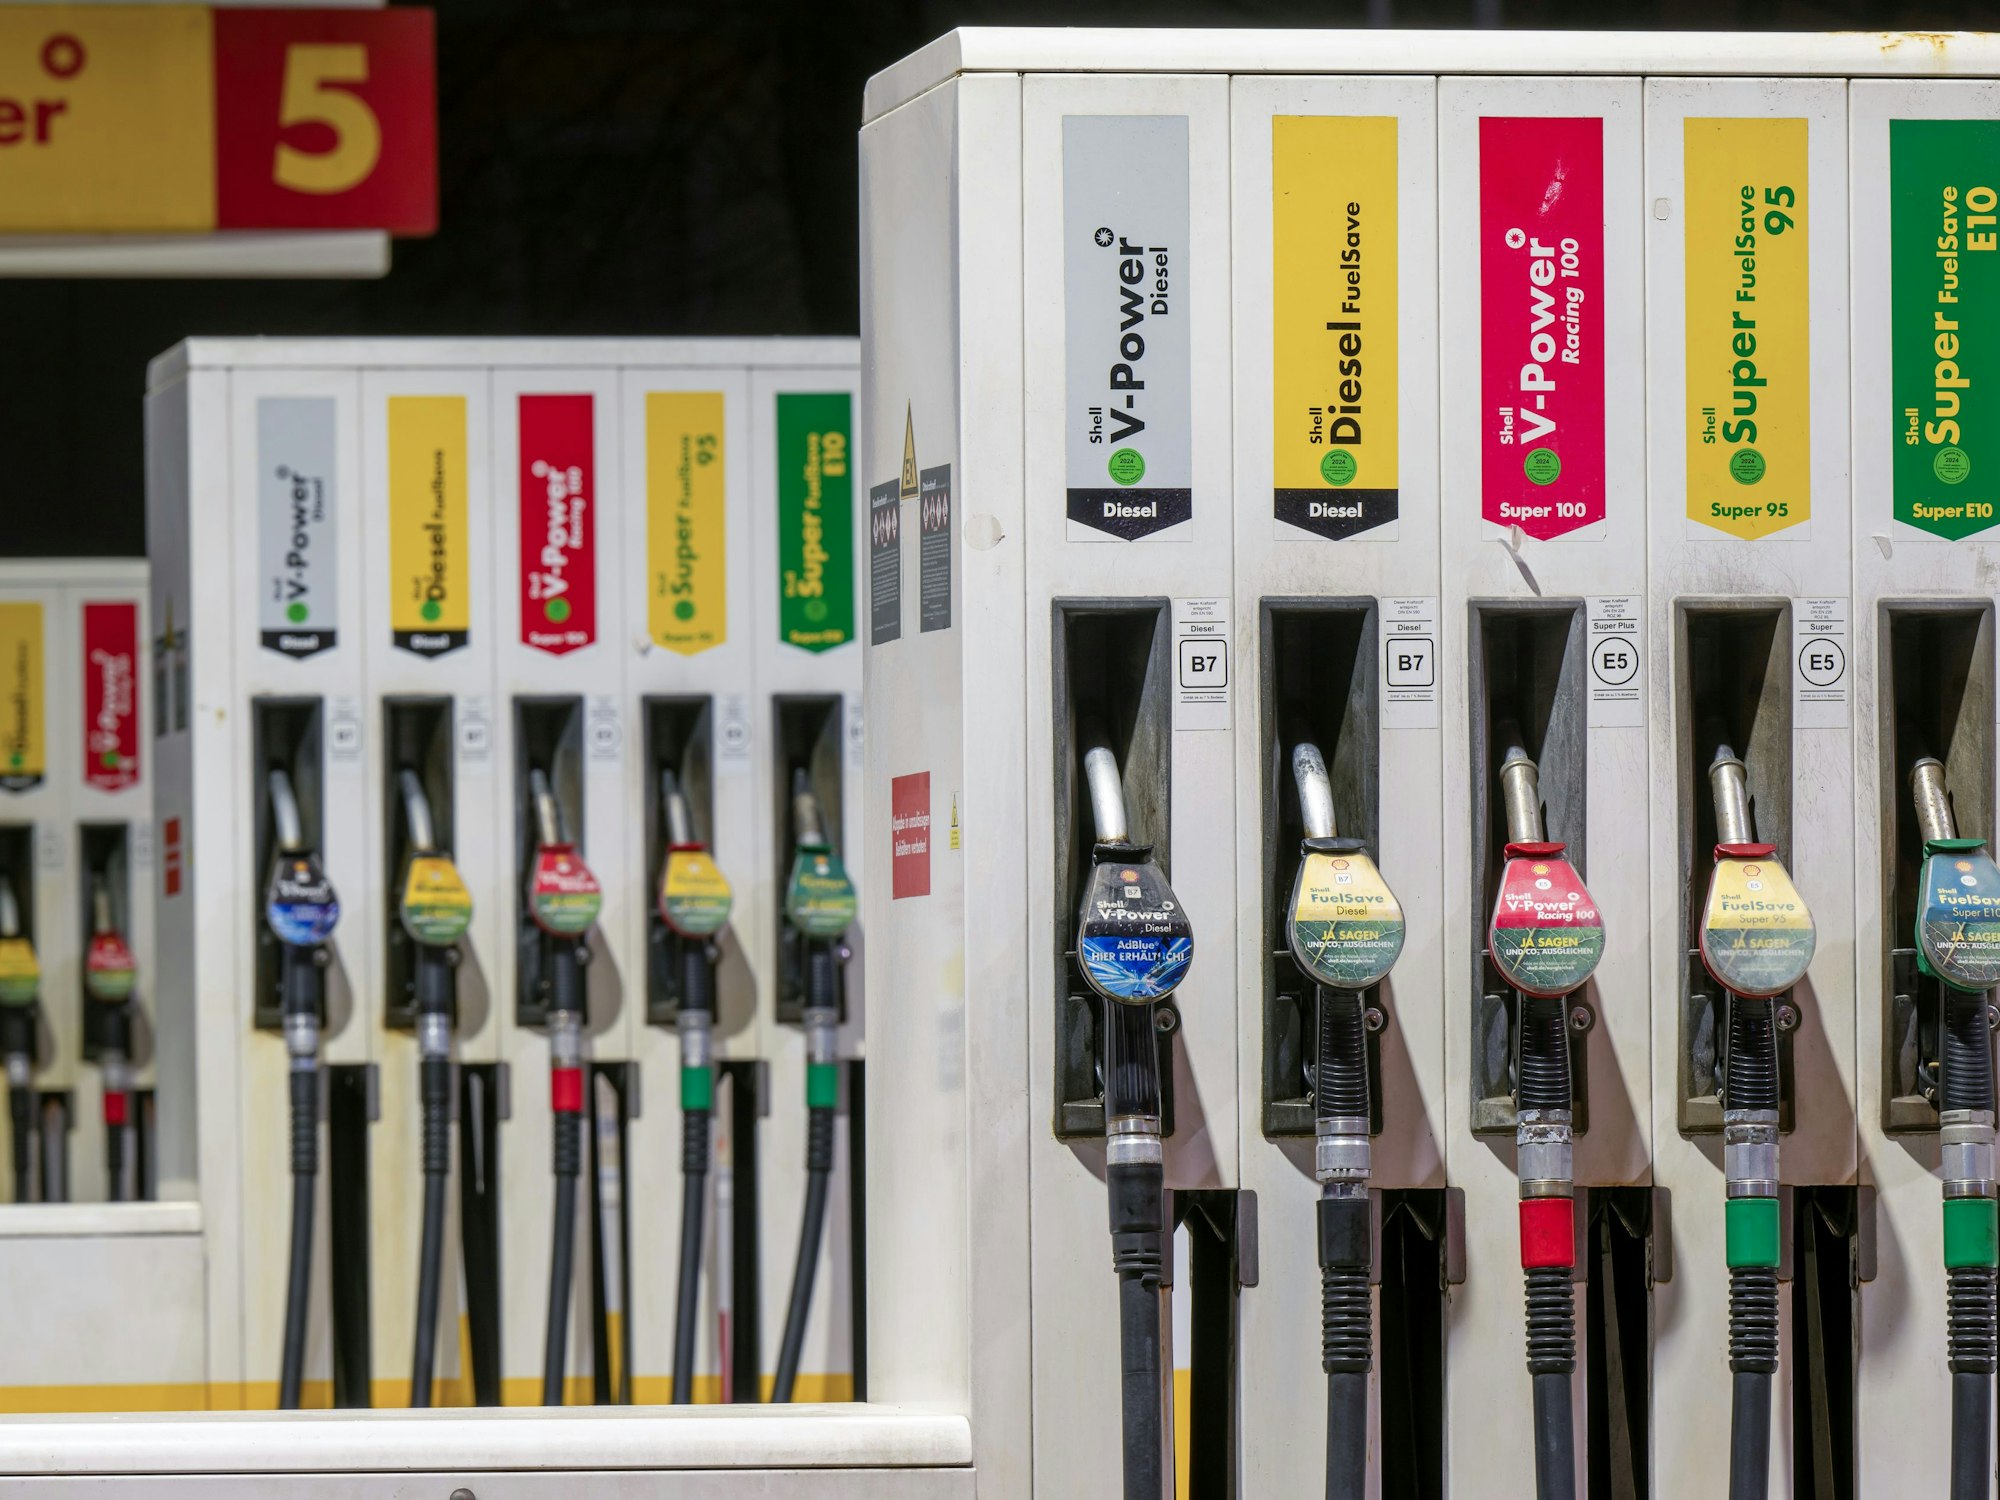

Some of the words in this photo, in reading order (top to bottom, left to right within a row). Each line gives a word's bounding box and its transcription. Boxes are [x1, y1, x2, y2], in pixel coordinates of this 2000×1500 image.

[272, 44, 382, 194] 5
[1764, 185, 1795, 236] 95
[1966, 186, 1998, 251] E10
[1340, 202, 1360, 314] FuelSave
[1562, 238, 1580, 278] 100
[1734, 185, 1756, 302] FuelSave
[1936, 186, 1958, 304] FuelSave
[1149, 247, 1168, 315] Diesel
[1110, 236, 1145, 444] V-Power
[1520, 237, 1556, 444] V-Power
[1560, 286, 1584, 364] Racing
[1326, 322, 1362, 445] Diesel
[1722, 311, 1767, 444] Super
[1924, 312, 1970, 445] Super
[1089, 407, 1102, 444] Shell
[1309, 407, 1322, 444] Shell
[1500, 406, 1514, 444] Shell
[1702, 407, 1716, 444] Shell
[1906, 408, 1919, 445] Shell
[696, 434, 716, 466] 95
[822, 432, 846, 476] E10
[1104, 502, 1157, 518] Diesel
[1310, 502, 1362, 518] Diesel
[1500, 502, 1552, 521] Super
[1556, 502, 1586, 518] 100
[1711, 502, 1762, 521] Super
[1766, 502, 1788, 517] 95
[1913, 502, 1964, 521] Super
[1966, 502, 1993, 518] E10
[286, 470, 309, 600] V-Power
[542, 466, 568, 599] V-Power
[424, 524, 446, 601] Diesel
[672, 515, 698, 596] Super
[798, 511, 828, 598] Super
[1594, 622, 1616, 630] Super
[1192, 656, 1217, 672] B7
[1398, 654, 1424, 671] B7
[1604, 654, 1628, 669] E5
[1810, 654, 1834, 670] E5
[1098, 909, 1170, 920] V-Power
[1311, 893, 1384, 903] FuelSave
[1337, 906, 1367, 915] Diesel
[1506, 901, 1575, 911] V-Power
[1722, 901, 1794, 911] FuelSave
[1953, 907, 1980, 919] Super
[1145, 924, 1171, 932] Diesel
[1537, 912, 1573, 921] Racing
[1740, 914, 1768, 926] Super
[1774, 914, 1786, 923] 95
[1322, 931, 1335, 940] JA
[1339, 931, 1379, 940] SAGEN
[1520, 938, 1534, 947] JA
[1538, 938, 1578, 947] SAGEN
[1732, 939, 1745, 948] JA
[1750, 939, 1789, 948] SAGEN
[1951, 932, 1964, 941] JA
[1968, 932, 2000, 942] SAGE
[1092, 952, 1116, 961] HIER
